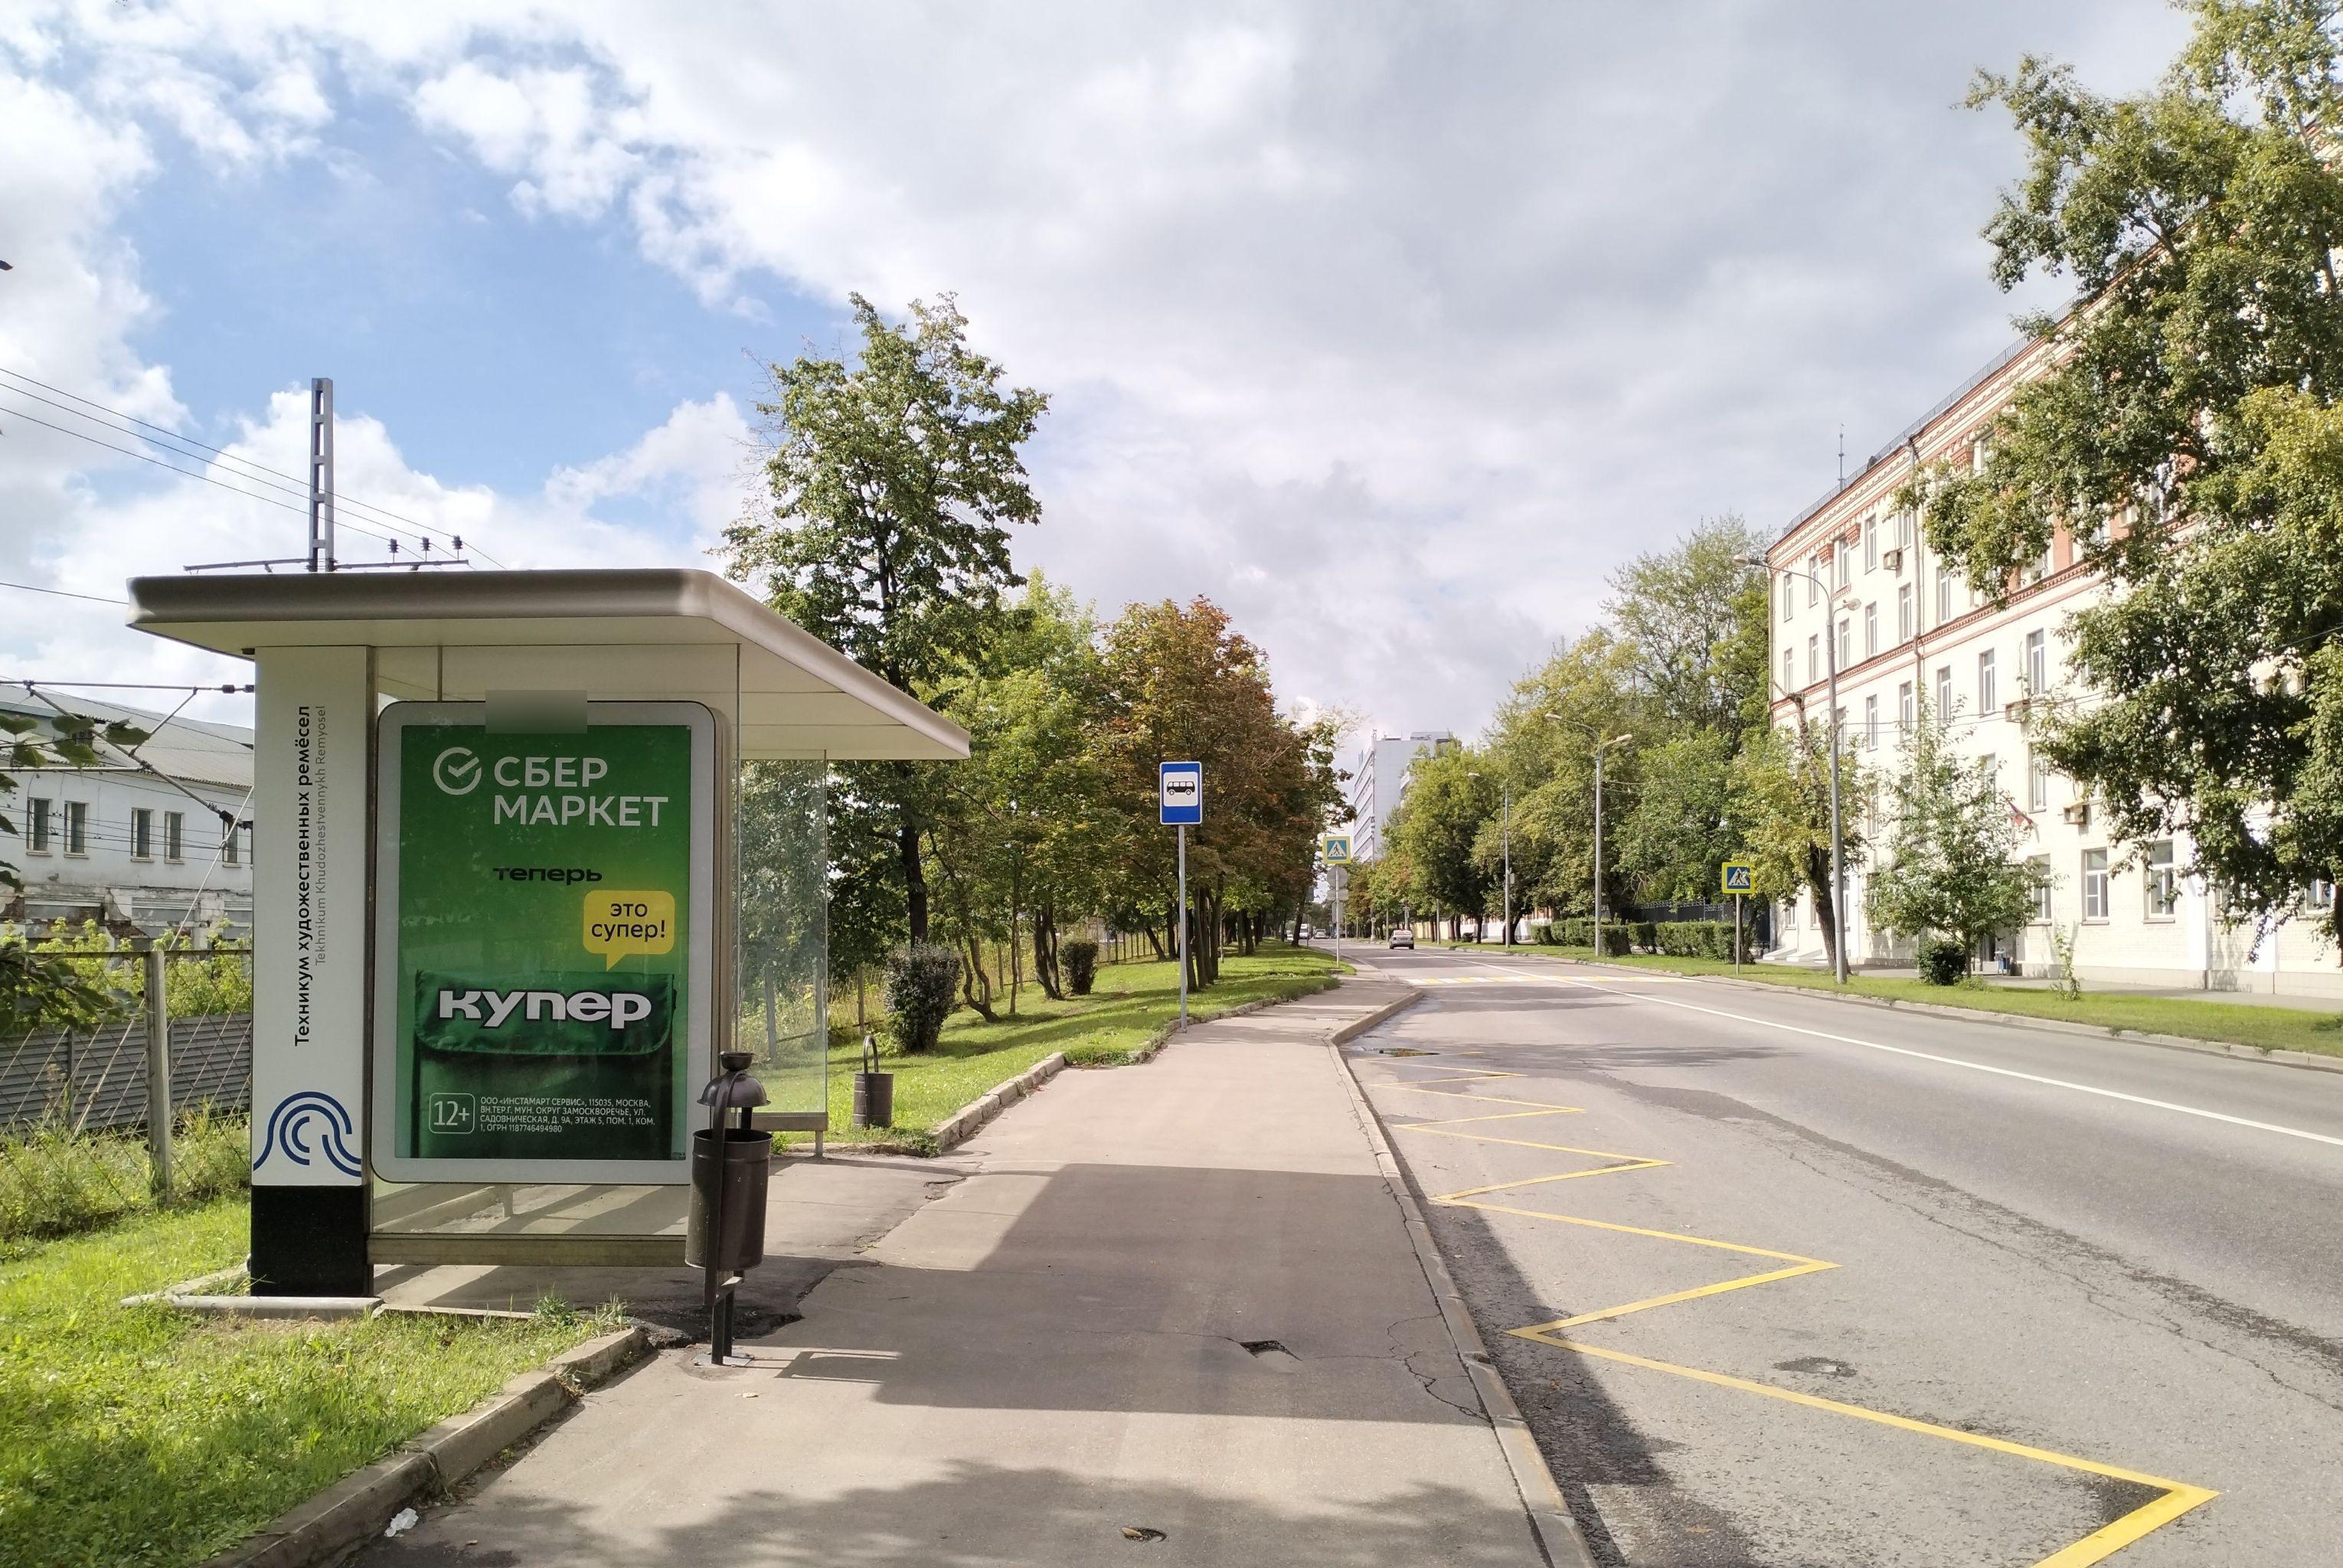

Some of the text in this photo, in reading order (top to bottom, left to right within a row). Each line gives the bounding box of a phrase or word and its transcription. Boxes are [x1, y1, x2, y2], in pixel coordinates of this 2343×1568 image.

[494, 756, 608, 787] СБЕР
[494, 795, 668, 827] МАРКЕТ
[315, 705, 328, 966] Tekhnikum Khudozhestvennykh Remyosel
[295, 706, 312, 1047] Техникум художественных ремёсел
[493, 867, 603, 885] теперь
[610, 903, 648, 917] это
[591, 920, 665, 942] супер!
[439, 991, 651, 1029] купер
[433, 1100, 470, 1125] 12+
[480, 1096, 498, 1105] ООО
[499, 1097, 551, 1106] «ИНСТАМАРТ
[589, 1099, 613, 1107] 115035,
[616, 1099, 651, 1108] МОСКВА,
[536, 1106, 561, 1115] ОКРУГ
[563, 1107, 632, 1116] ЗАМОСКВОРЕЧЬЕ,
[480, 1115, 550, 1124] САДОВНИЧЕСКАЯ,
[509, 1124, 562, 1132] 1187746494980
